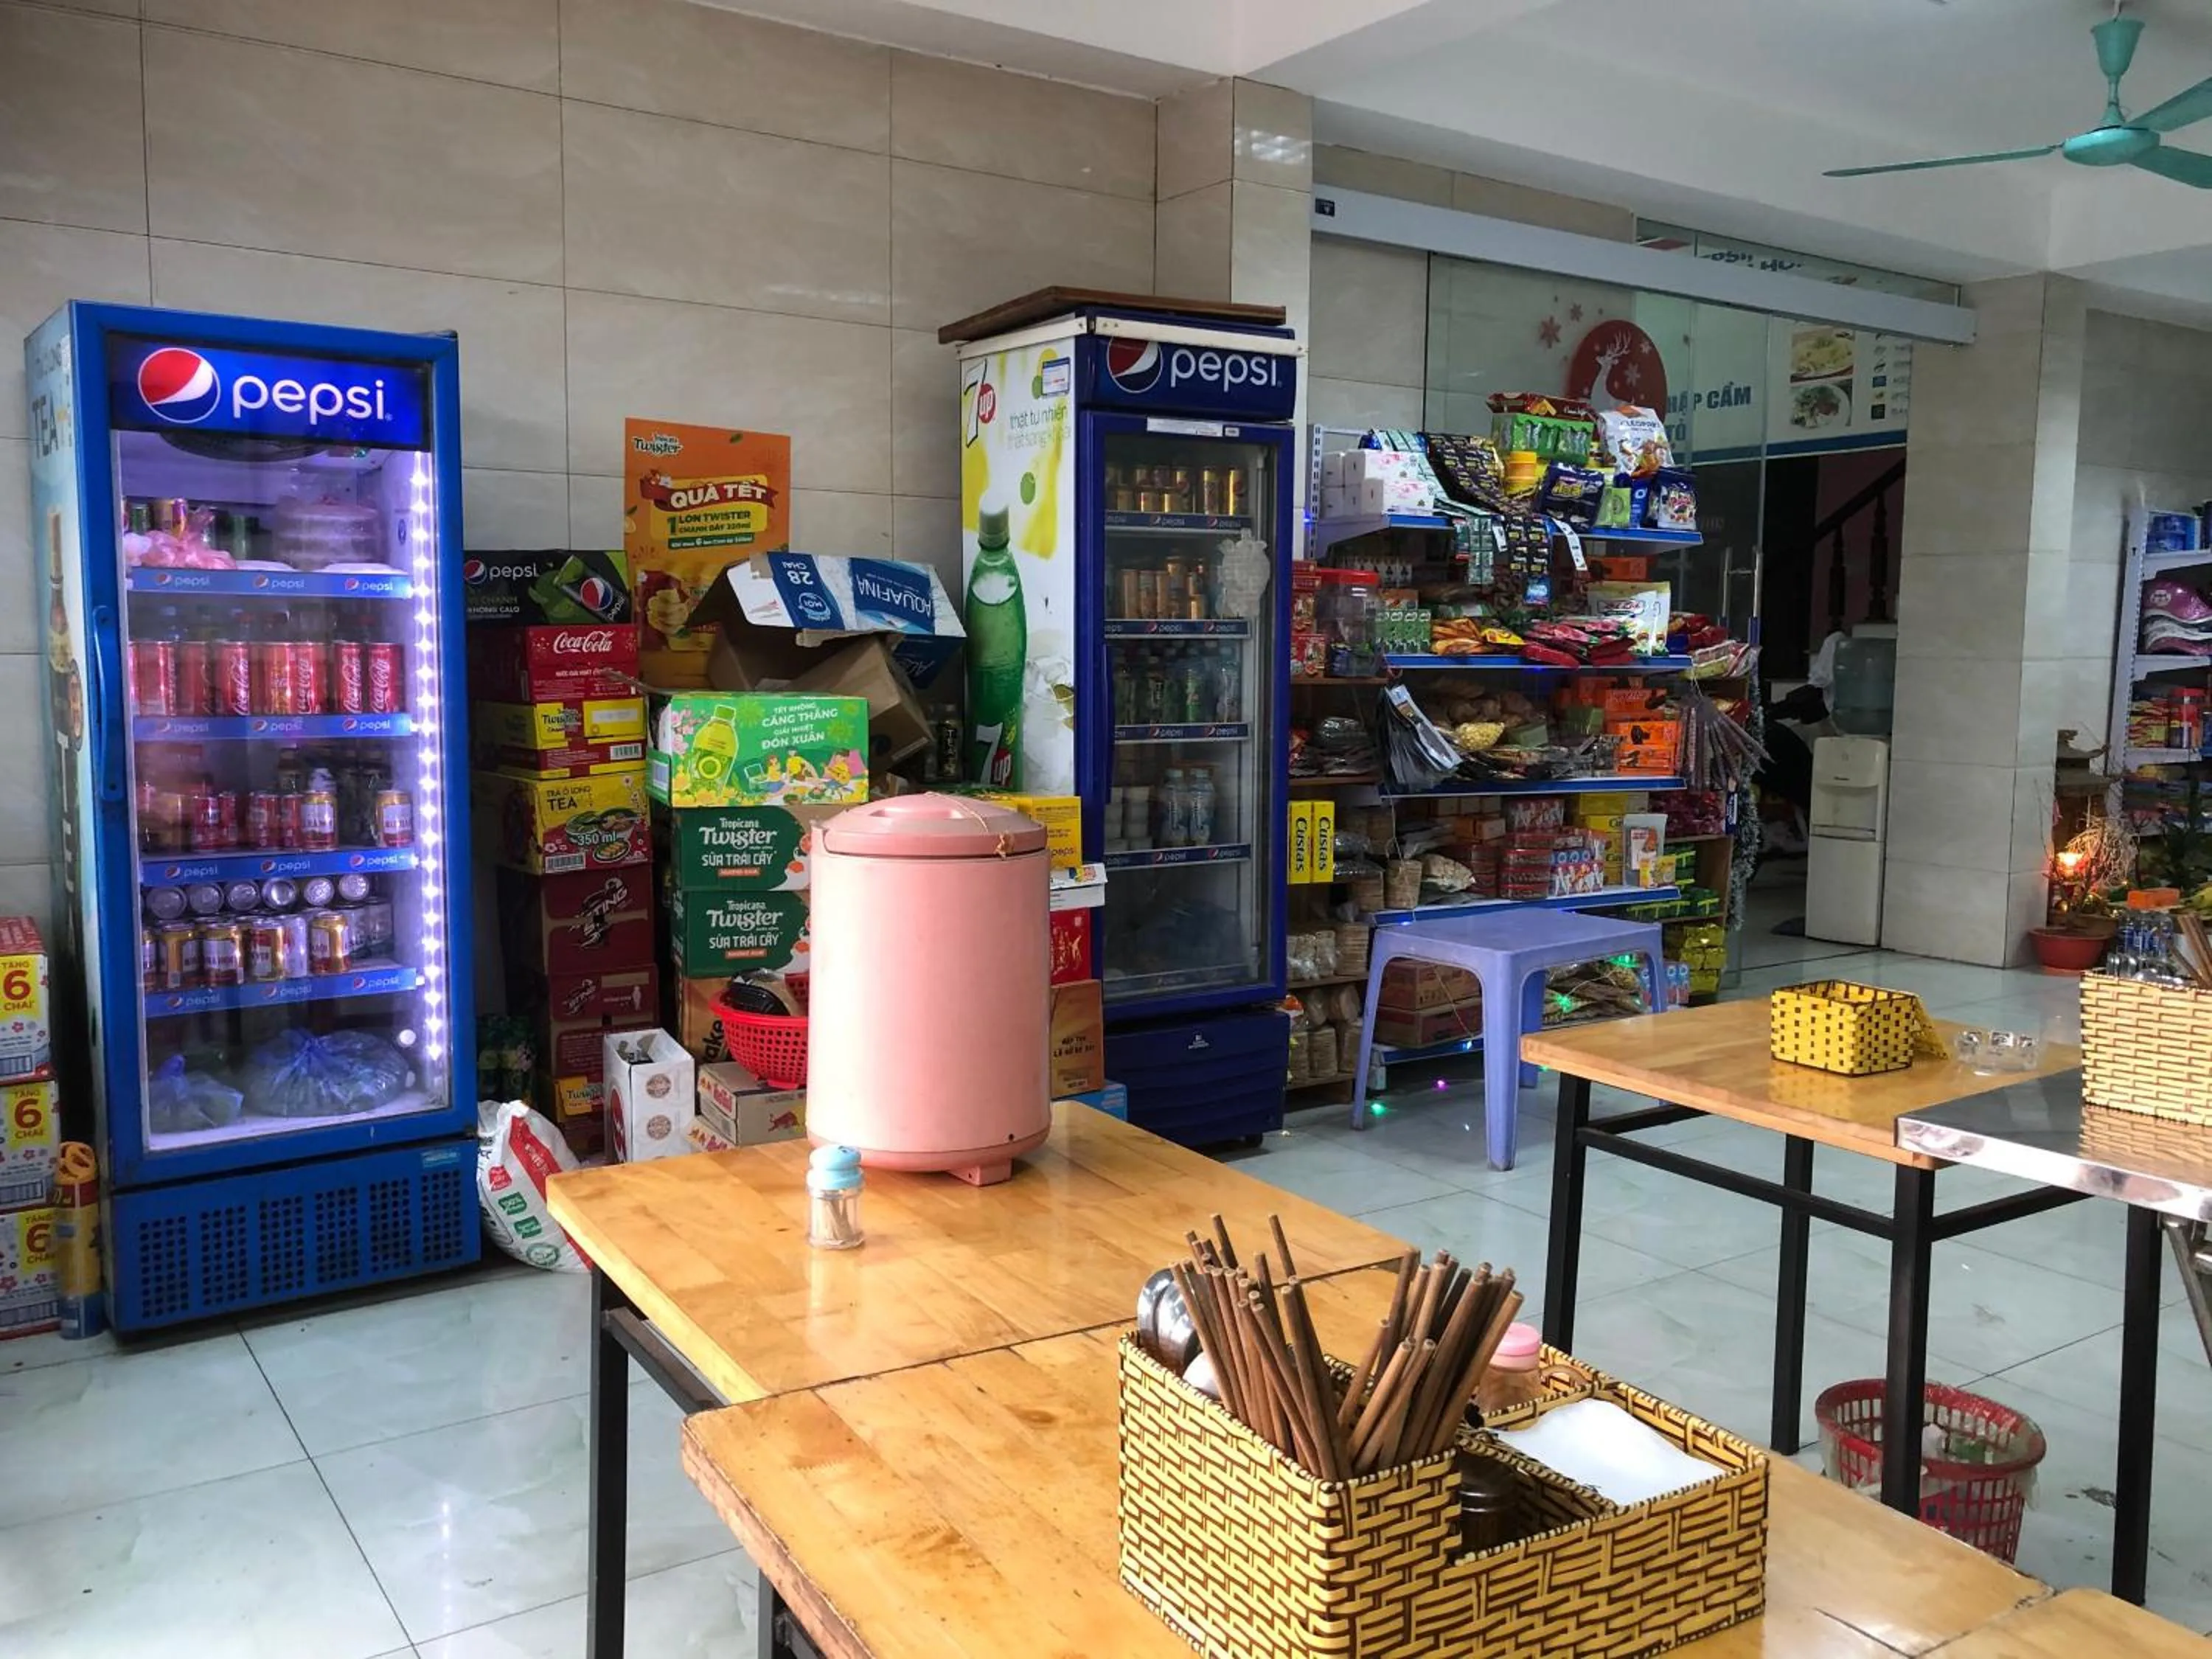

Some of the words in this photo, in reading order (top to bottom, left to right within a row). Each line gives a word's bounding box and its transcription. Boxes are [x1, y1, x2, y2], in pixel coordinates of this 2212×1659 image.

[1170, 349, 1277, 392] pepsi
[232, 373, 386, 425] pepsi
[489, 563, 539, 581] pepsi
[786, 569, 814, 585] 28
[361, 580, 394, 591] pepsi
[855, 574, 933, 618] AQUAFINA
[359, 719, 391, 731] pepsi
[719, 817, 759, 830] Tropicana
[577, 835, 600, 846] 350
[601, 831, 617, 844] ml
[698, 827, 779, 850] Twister
[366, 854, 399, 866] pepsi
[726, 849, 751, 866] TRÁI
[726, 900, 767, 912] Tropicana
[706, 909, 784, 931] Twister
[3, 970, 31, 1000] 6
[15, 1098, 42, 1129] 6
[26, 1223, 51, 1253] 6
